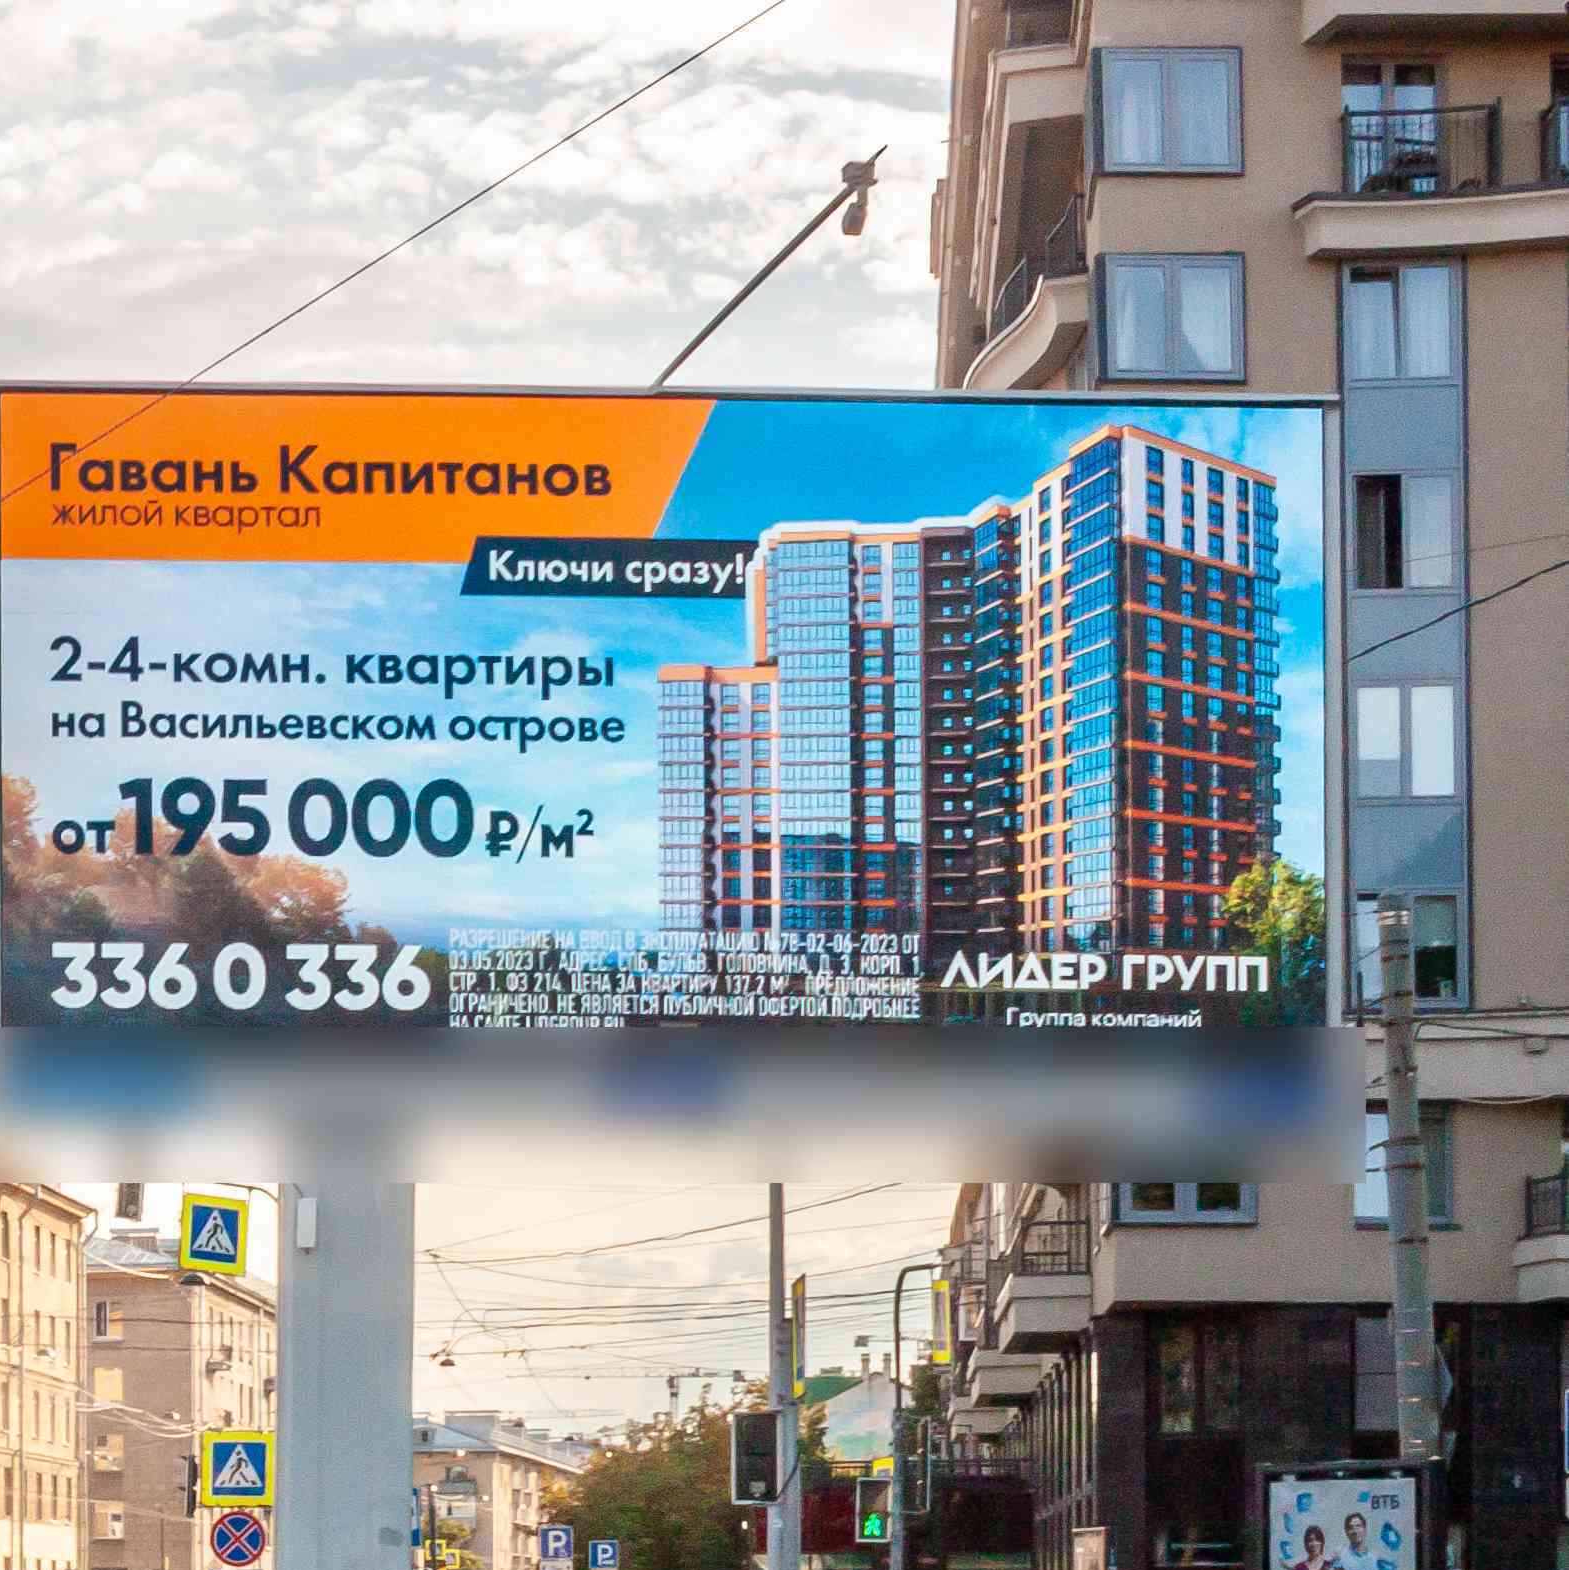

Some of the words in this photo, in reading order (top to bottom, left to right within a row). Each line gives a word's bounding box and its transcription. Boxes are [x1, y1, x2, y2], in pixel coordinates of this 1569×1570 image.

[49, 442, 259, 493] Гавань
[278, 444, 613, 497] Капитанов
[51, 500, 163, 528] жилой
[174, 504, 322, 535] квартал
[488, 549, 614, 583] Ключи
[624, 552, 744, 594] сразу!
[49, 635, 328, 684] 2-4-комн.
[345, 653, 615, 700] квартиры
[50, 711, 106, 739] на
[120, 699, 437, 742] Васильевском
[448, 714, 626, 754] острове
[52, 819, 116, 855] от
[118, 776, 272, 857] 195
[287, 777, 475, 858] 000
[448, 950, 534, 971] 03.05.2023
[449, 928, 555, 950] РАЗРЕШЕНИЕ
[556, 929, 575, 950] НА
[579, 929, 621, 951] ВВОД
[901, 933, 921, 954] ОТ
[50, 941, 198, 1010] 336
[212, 941, 267, 1010] 0
[284, 942, 432, 1011] 336
[570, 972, 612, 995] ЦЕНА
[615, 974, 636, 994] ЗА
[640, 974, 719, 996] КВАРТИРУ
[804, 975, 921, 997] ПРЕДЛОЖЕНИЕ
[939, 949, 1109, 990] ЛИДЕР
[1122, 953, 1270, 993] ГРУПП
[556, 993, 576, 1014] НЕ
[580, 993, 659, 1015] ЯВЛЯЕТСЯ
[662, 994, 756, 1016] ПУБЛИЧНОЙ
[1005, 1007, 1086, 1028] Группа
[1091, 1008, 1203, 1028] компаний
[1371, 1494, 1400, 1510] ВТБ
